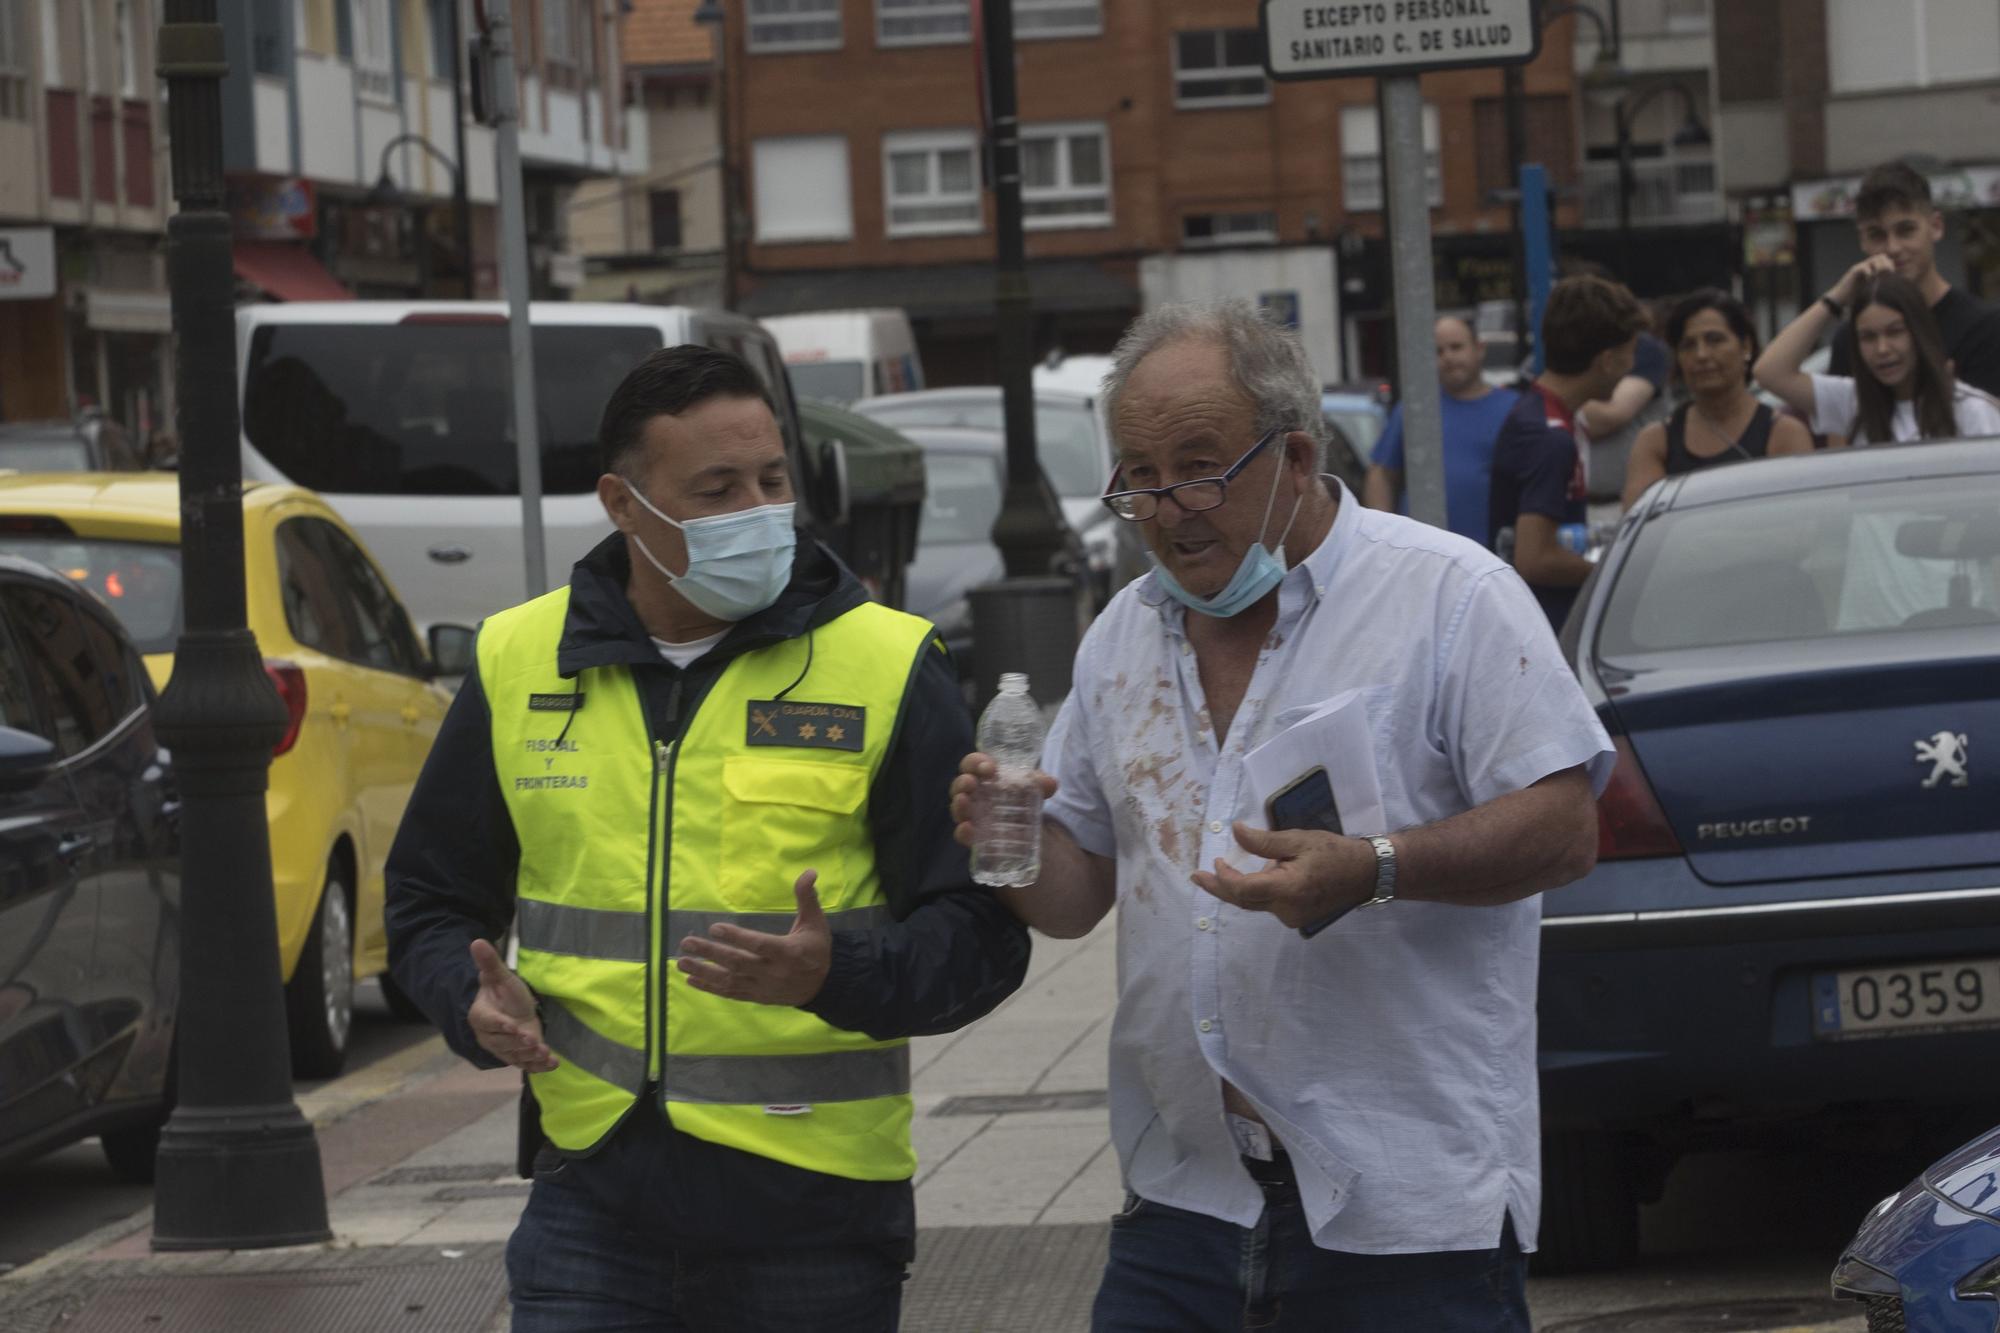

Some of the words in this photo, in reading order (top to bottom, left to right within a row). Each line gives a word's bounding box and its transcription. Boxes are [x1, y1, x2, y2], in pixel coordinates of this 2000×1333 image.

[1303, 4, 1386, 29] EXCEPTO
[1395, 0, 1491, 22] PERSONAL
[1291, 35, 1384, 61] SANITARIO
[1393, 34, 1412, 52] C.
[1420, 30, 1443, 51] DE
[1453, 25, 1512, 48] SALUD
[782, 704, 829, 717] GUARDIA
[832, 707, 861, 721] CIVIL
[526, 739, 579, 753] FISCAL
[545, 758, 554, 770] Y
[515, 775, 588, 791] FRONTERAS
[1697, 816, 1811, 840] PEUGEOT
[1852, 968, 1984, 1021] 0359
